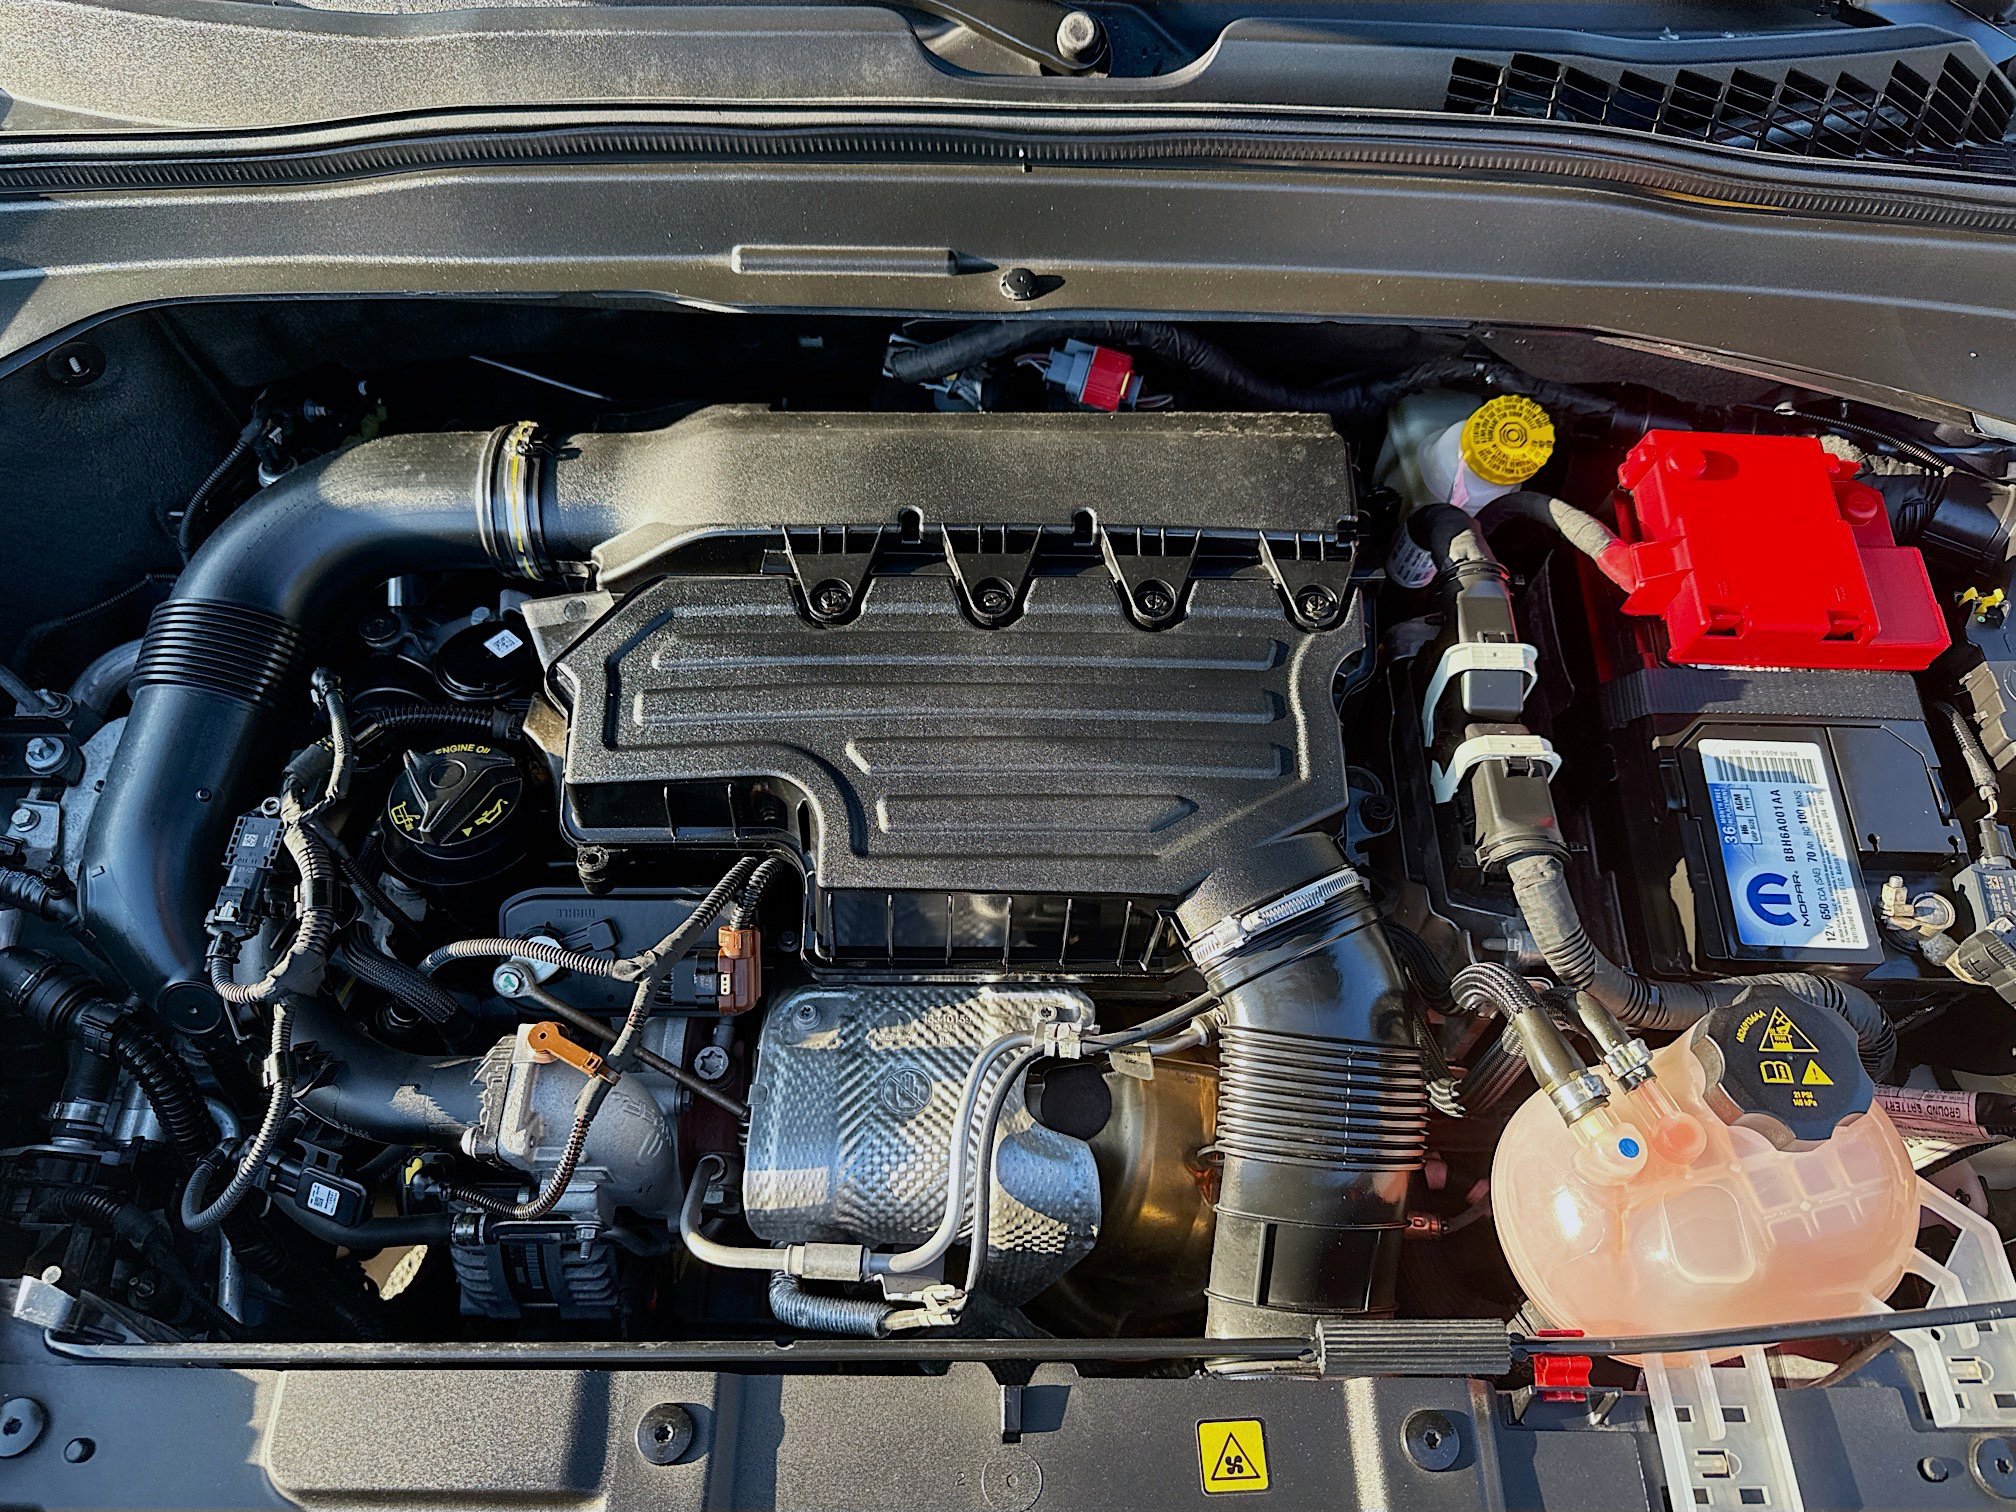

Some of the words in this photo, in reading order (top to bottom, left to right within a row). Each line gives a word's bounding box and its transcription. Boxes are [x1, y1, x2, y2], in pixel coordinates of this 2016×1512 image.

[435, 744, 475, 755] ENGINE
[1714, 788, 1722, 801] FREE
[1794, 790, 1803, 807] MINS
[1734, 794, 1744, 811] AGM
[1744, 796, 1752, 809] TYPE
[1719, 803, 1727, 824] MONTH
[1796, 809, 1808, 824] 100
[1748, 818, 1756, 829] SIZE
[1770, 789, 1796, 862] BBH6A001AA
[1723, 826, 1738, 844] 36
[1801, 827, 1811, 836] RC
[1807, 852, 1817, 862] 70
[1813, 868, 1824, 885] (SAE)
[1792, 874, 1810, 927] MOPAR
[1817, 887, 1827, 901] CCA
[1819, 904, 1831, 920] 650
[1825, 931, 1836, 941] 12
[1885, 1100, 1922, 1114] BATTERY
[1926, 1104, 1961, 1118] GROUND
